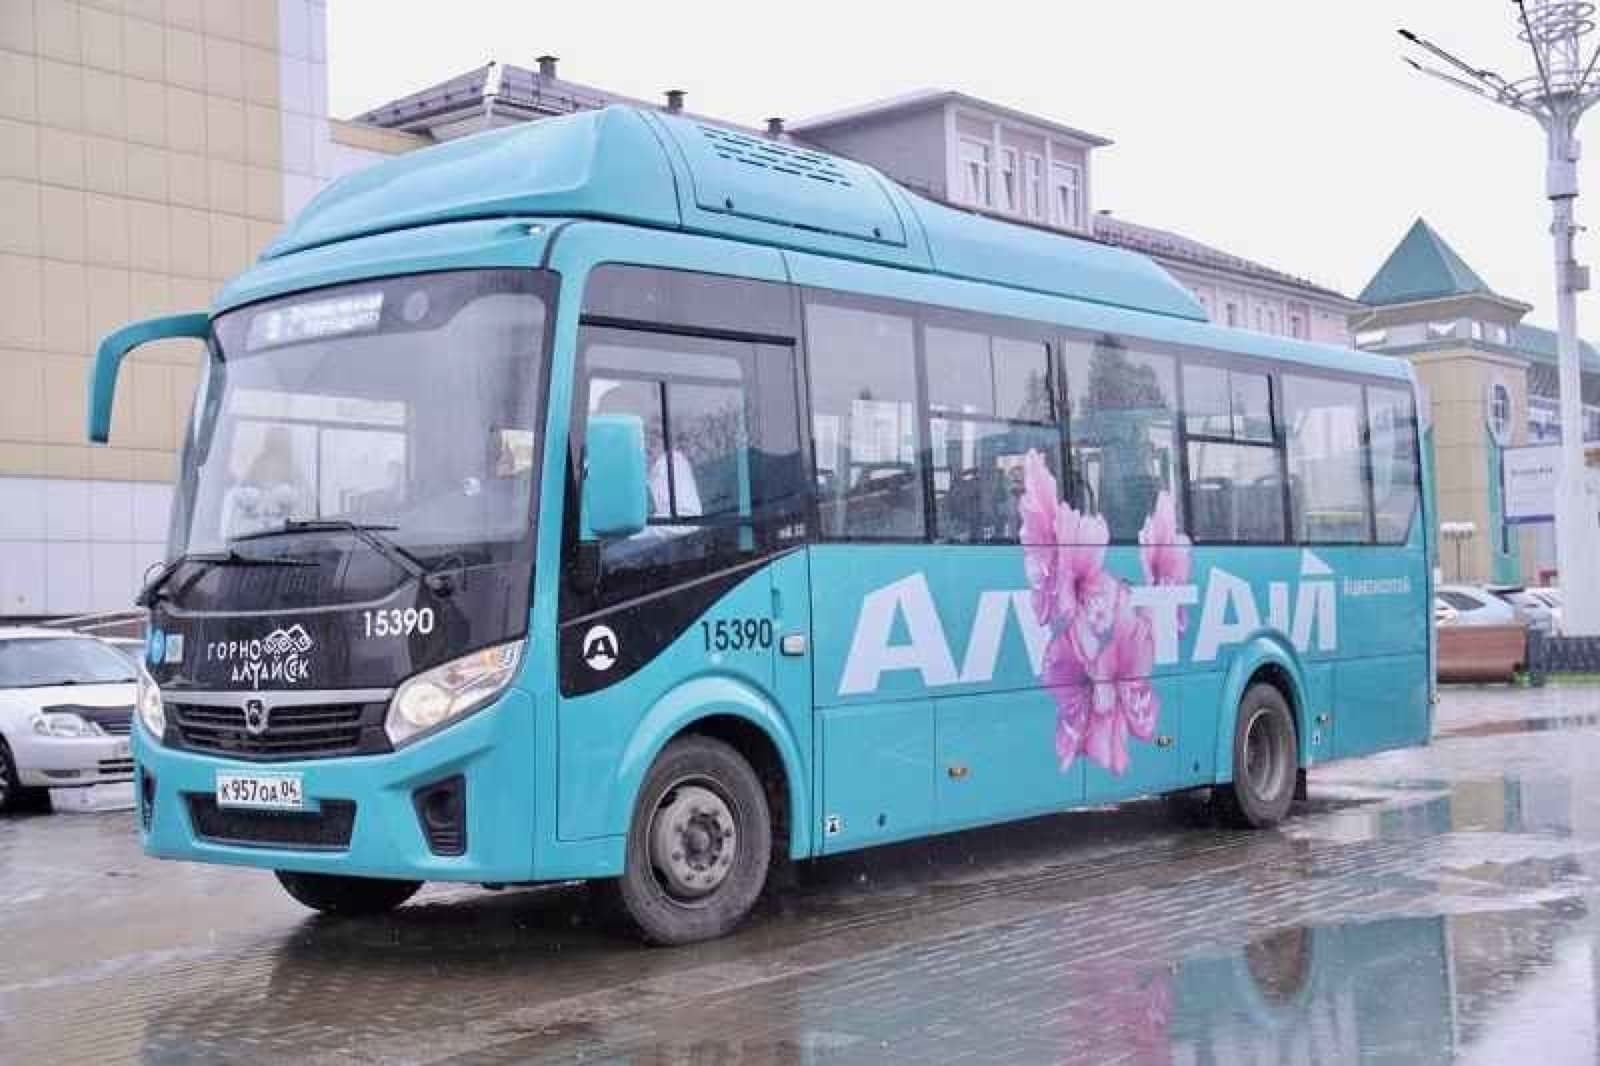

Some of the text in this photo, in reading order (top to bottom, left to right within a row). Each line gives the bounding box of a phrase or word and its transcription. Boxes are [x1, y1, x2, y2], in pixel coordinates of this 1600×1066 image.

[363, 607, 434, 637] 15390
[701, 618, 772, 651] 15390
[207, 640, 261, 661] ГОРНО
[231, 652, 310, 689] АЛТАЙСК
